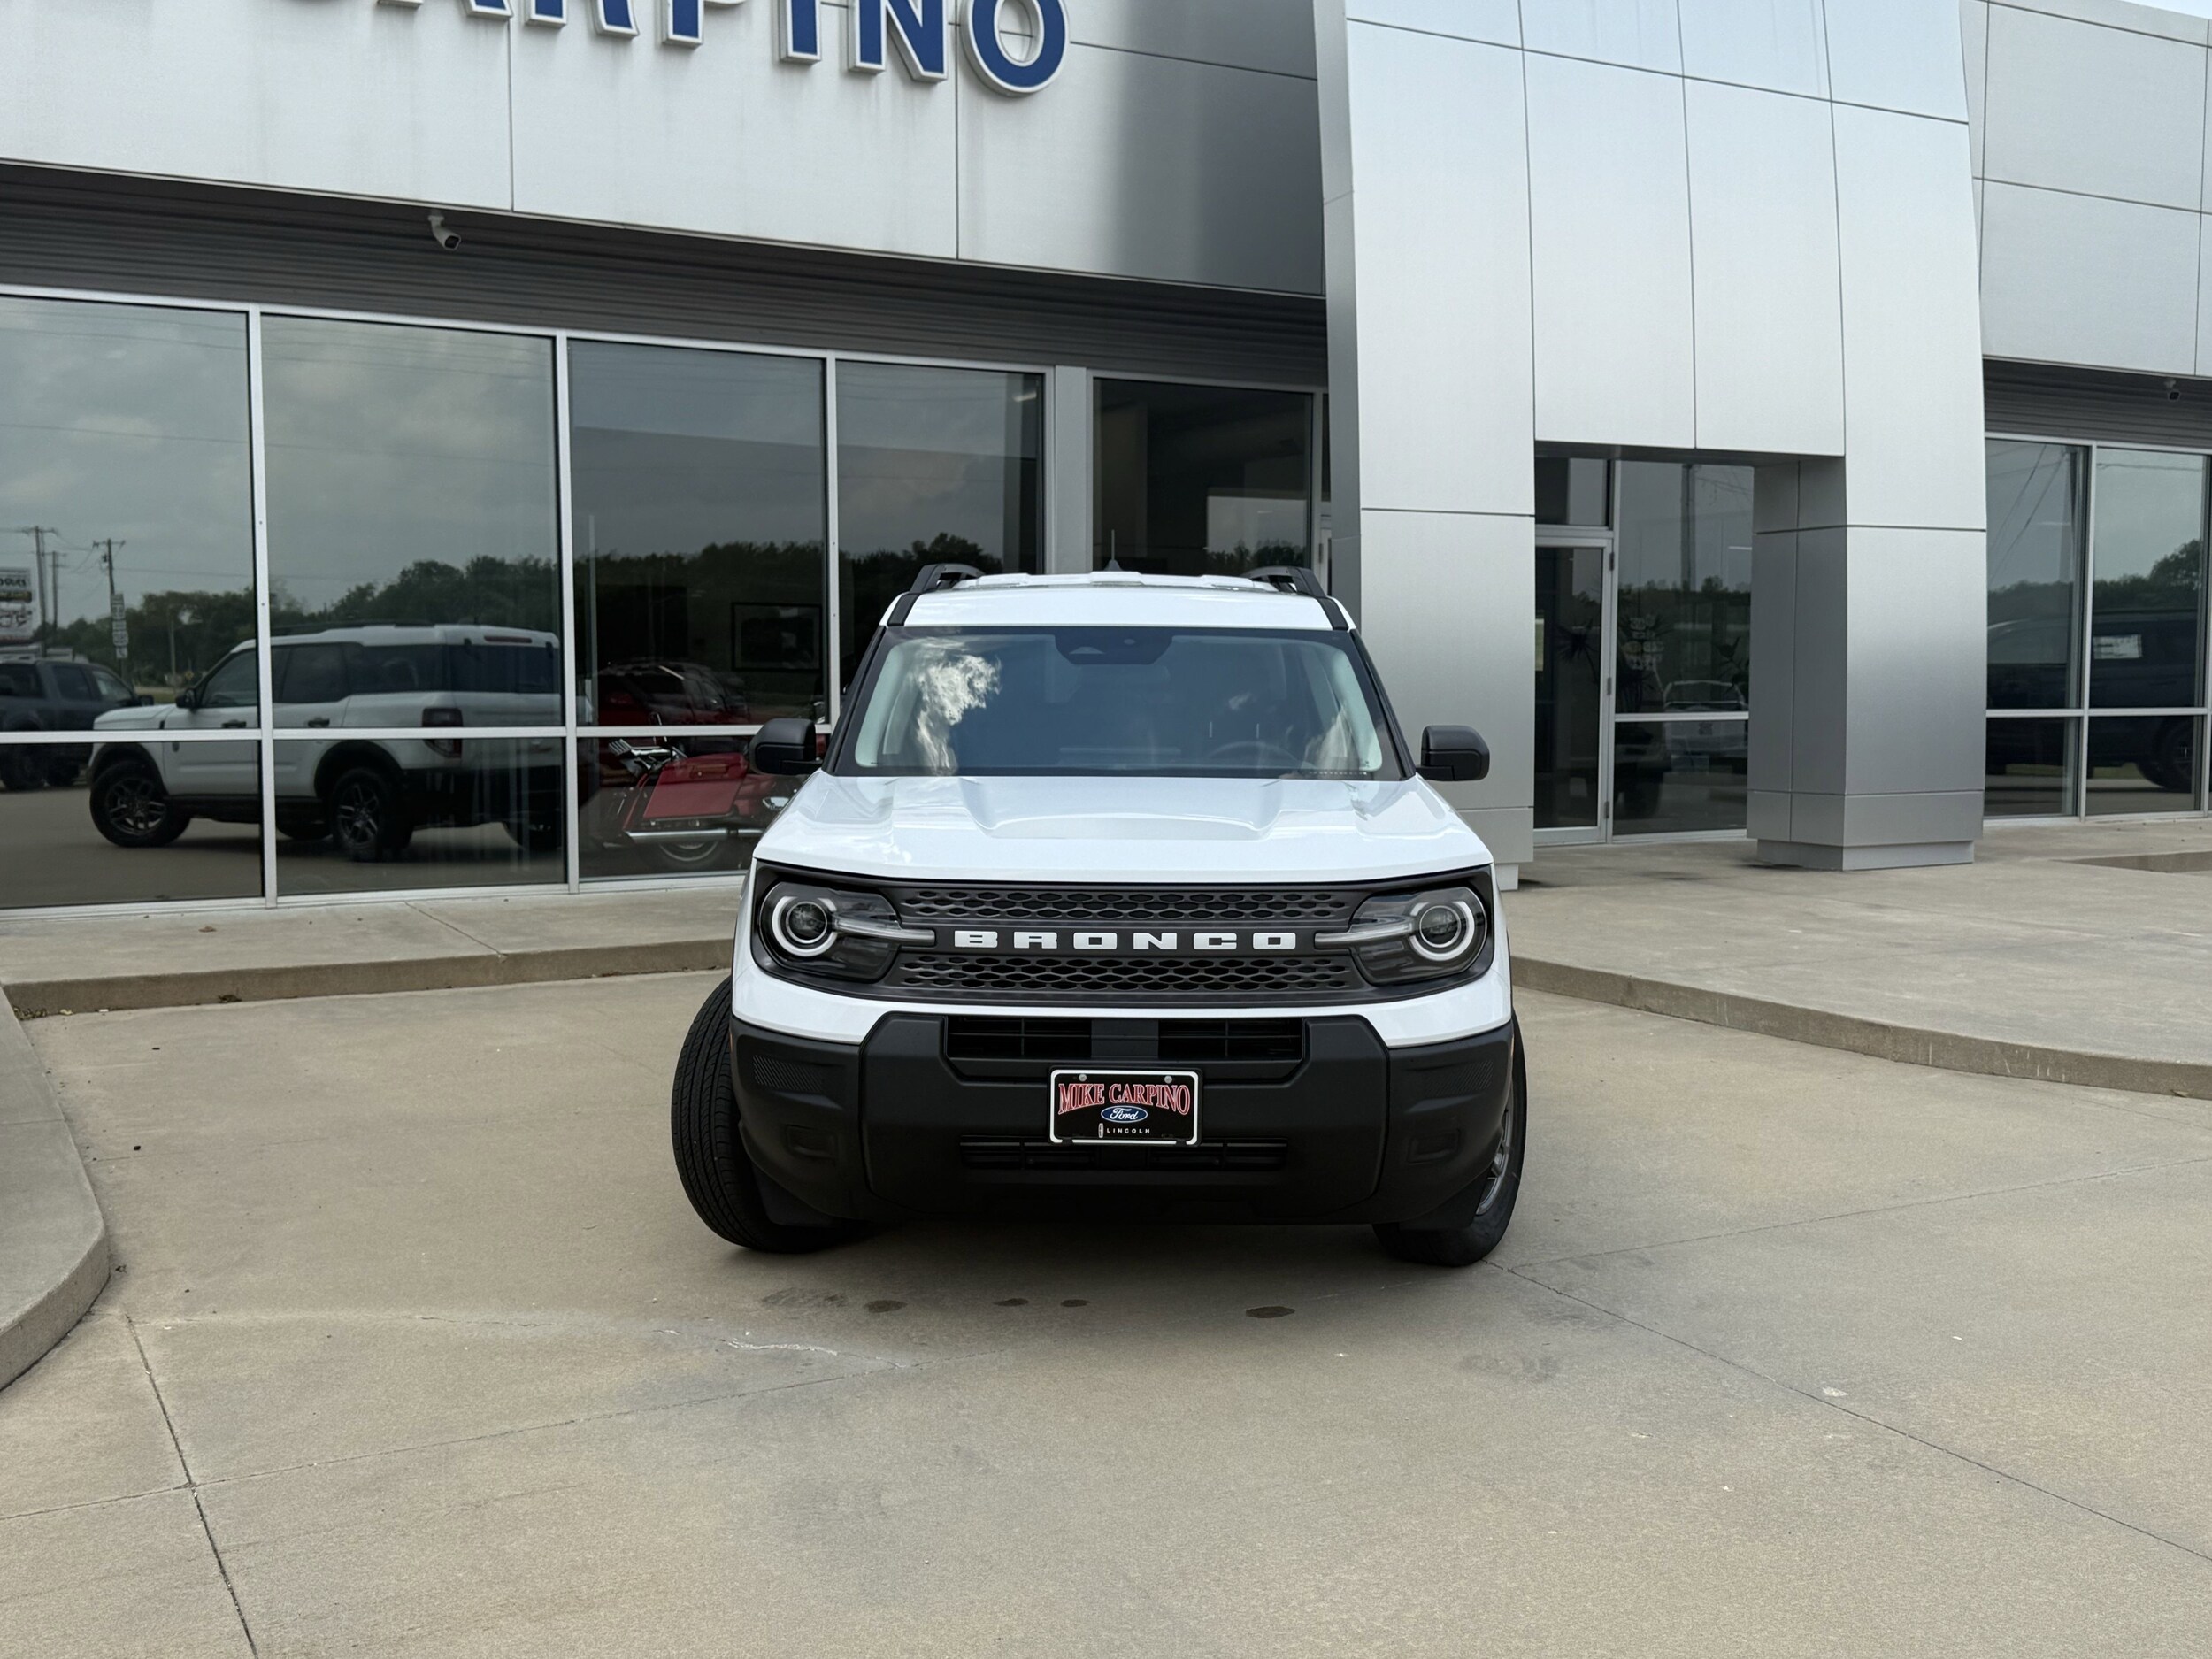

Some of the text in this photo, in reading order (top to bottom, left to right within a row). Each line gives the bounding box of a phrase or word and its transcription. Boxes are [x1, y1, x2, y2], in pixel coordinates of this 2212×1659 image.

[954, 930, 1296, 950] BRONCO
[1058, 1083, 1191, 1116] MIKE CARPINO
[1109, 1107, 1139, 1120] Ford
